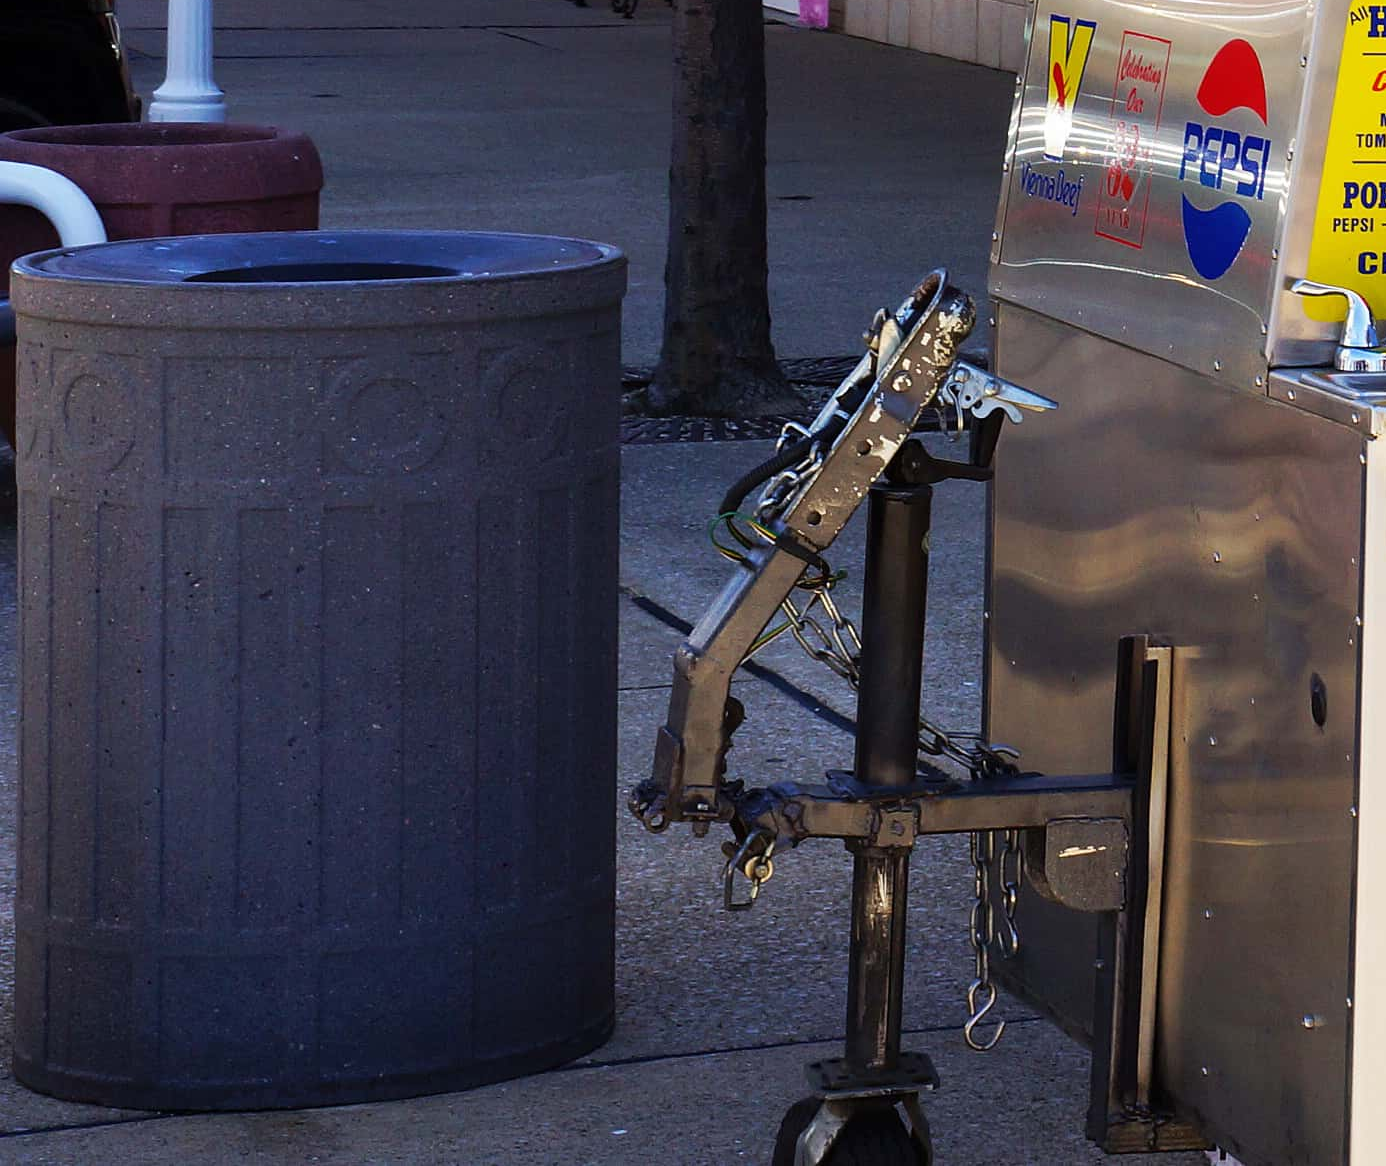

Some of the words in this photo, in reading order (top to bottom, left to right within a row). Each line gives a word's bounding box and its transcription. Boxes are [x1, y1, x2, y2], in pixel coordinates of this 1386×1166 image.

[1350, 6, 1368, 26] All
[1179, 121, 1272, 200] PEPSI
[1020, 160, 1056, 201] Vienna
[1057, 168, 1084, 216] Beef
[1332, 218, 1374, 232] PEPSI
